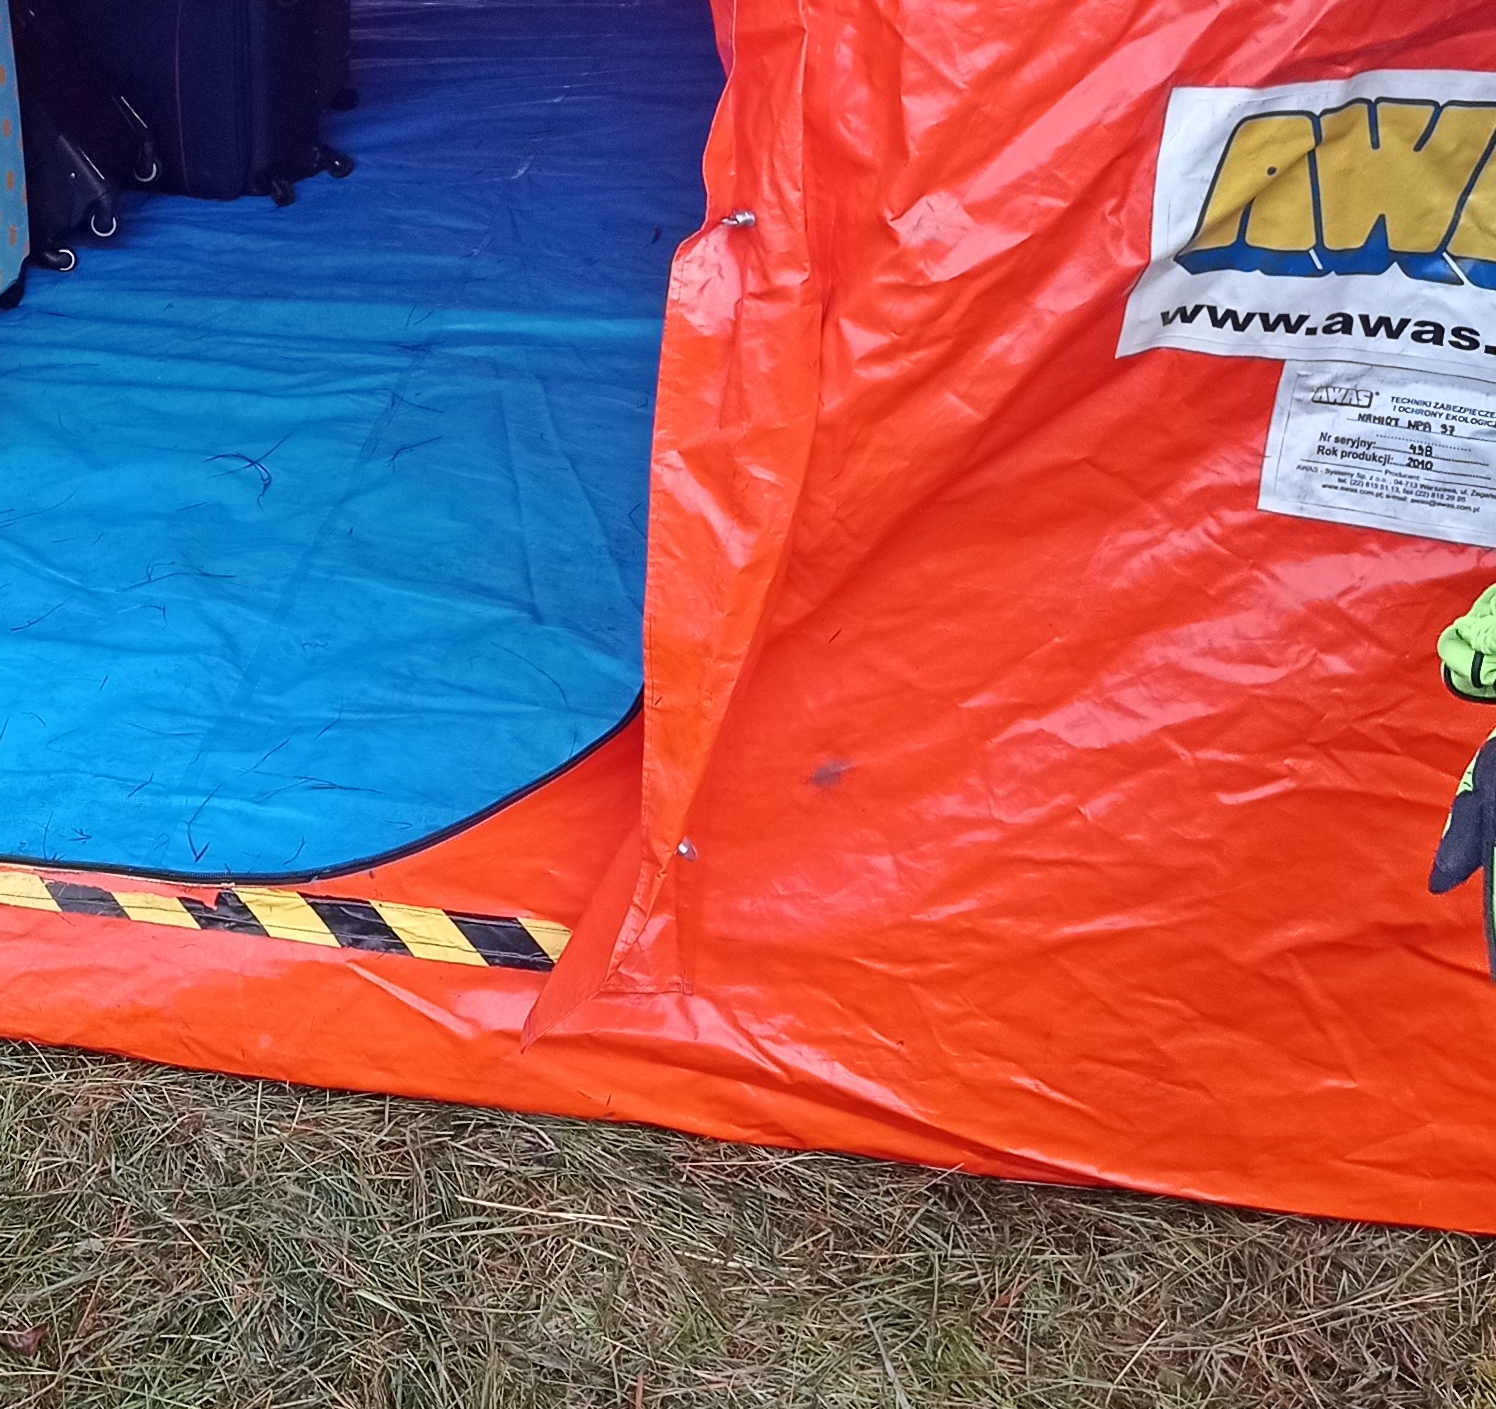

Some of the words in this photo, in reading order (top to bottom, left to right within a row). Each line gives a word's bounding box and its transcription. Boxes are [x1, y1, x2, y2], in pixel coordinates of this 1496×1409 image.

[1391, 396, 1432, 407] TECHNIKI
[1398, 406, 1443, 418] OCHRONY
[1319, 432, 1331, 443] Nr
[1334, 435, 1376, 450] seryjny:
[1316, 445, 1338, 457] Rok
[1340, 447, 1394, 467] produkcji:
[1405, 457, 1433, 471] 2010
